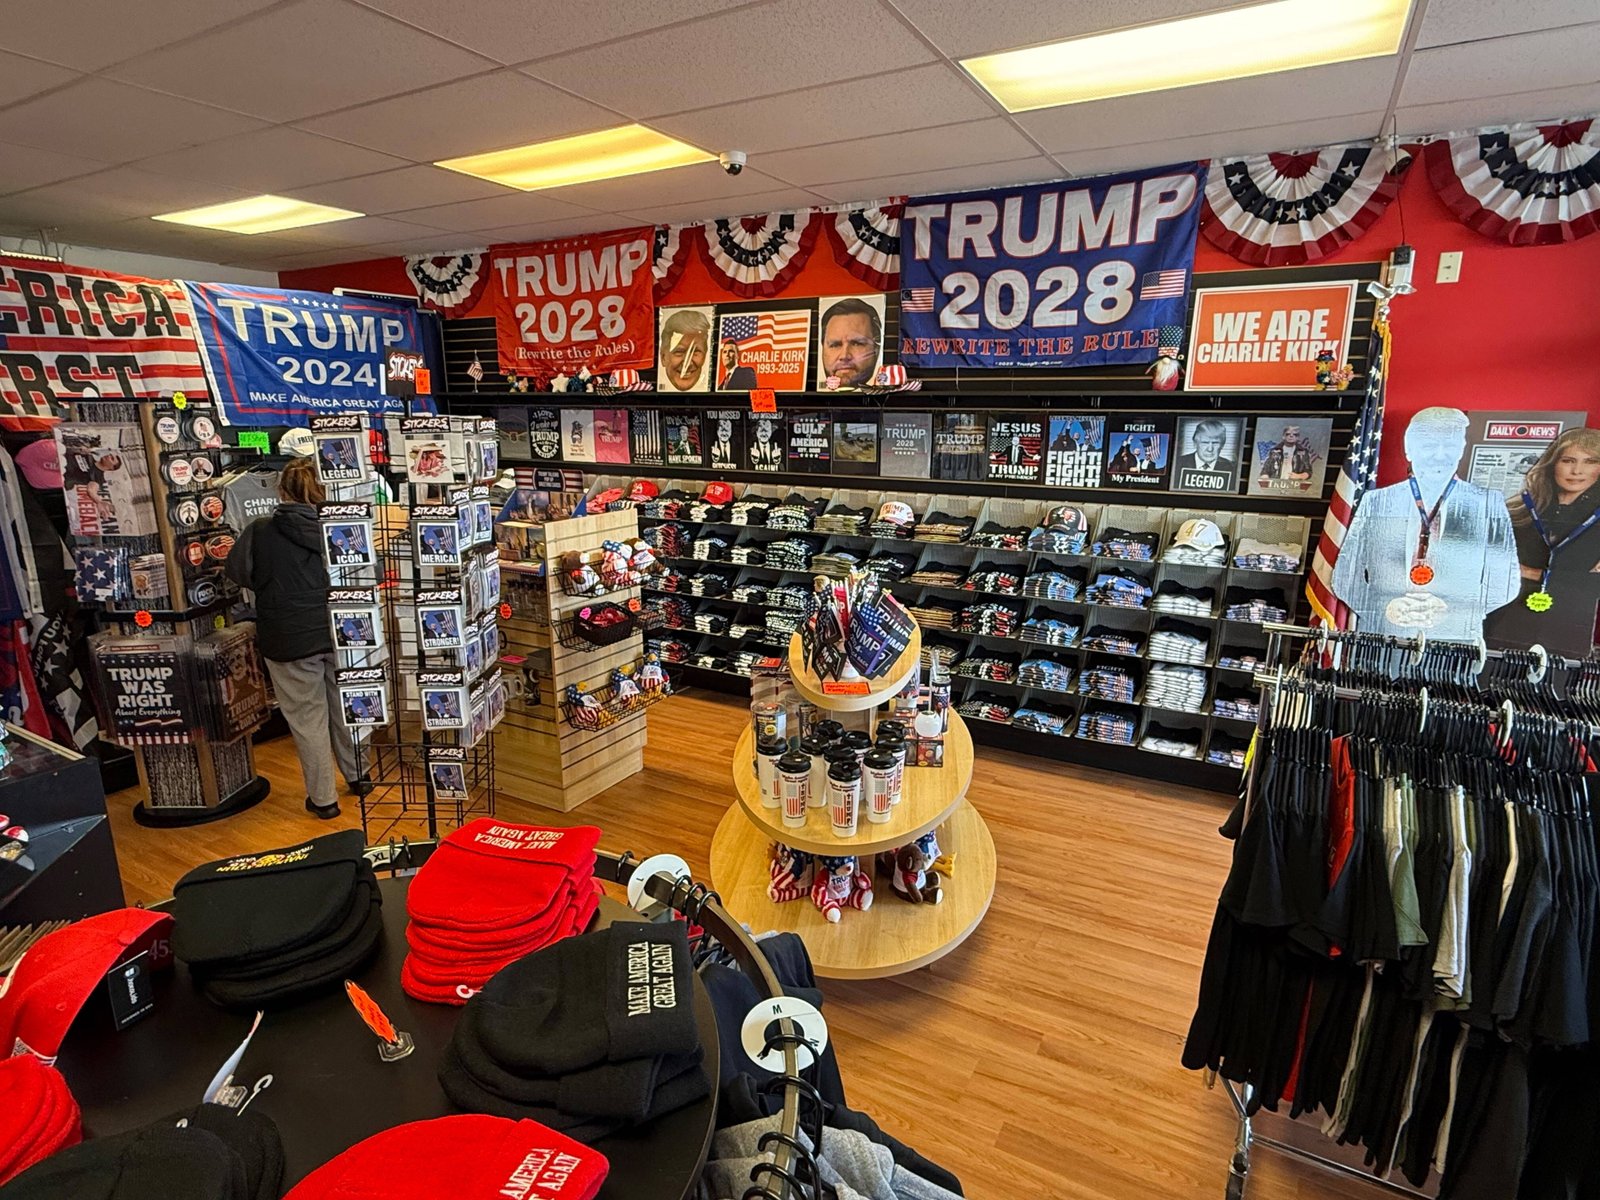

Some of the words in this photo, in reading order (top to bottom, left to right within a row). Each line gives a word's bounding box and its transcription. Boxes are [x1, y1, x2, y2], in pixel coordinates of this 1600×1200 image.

[903, 174, 1197, 260] TRUMP
[494, 239, 647, 297] TRUMP
[940, 261, 1136, 331] 2028
[515, 295, 626, 344] 2028
[1212, 311, 1262, 342] WE
[1265, 309, 1330, 341] ARE
[217, 298, 405, 354] TRUMP
[1019, 337, 1073, 356] THE
[1082, 329, 1159, 352] RULE
[514, 345, 563, 361] (Rewrite
[567, 344, 591, 359] the
[595, 339, 635, 357] Rules)
[1197, 342, 1281, 363] CHARLIE
[1284, 340, 1340, 362] KIRK
[741, 350, 780, 364] CHARLIE
[781, 349, 805, 362] KIRK
[276, 356, 377, 388] 2024
[756, 363, 800, 374] 1993-2025
[249, 391, 288, 404] MAKE
[291, 394, 342, 408] AMERICA
[344, 400, 380, 409] GREAT
[384, 400, 404, 409] AGA
[706, 411, 718, 420] YOU
[718, 411, 740, 420] MISSED
[312, 416, 358, 428] STICKERS
[402, 418, 449, 430] STICKERS
[991, 423, 1042, 433] JESUS
[793, 423, 825, 435] GULF
[884, 428, 926, 440] TRUMP
[1124, 424, 1156, 433] FIGHT!
[1489, 426, 1515, 437] DAILY
[1528, 426, 1556, 437] NEWS
[531, 431, 560, 443] TRUMP
[790, 438, 829, 448] AMERICA
[936, 433, 985, 445] TRUMP
[895, 440, 915, 448] 2028
[1047, 451, 1103, 465] FIGHT!
[322, 469, 360, 480] LEGEND
[989, 464, 1039, 475] TRUMP
[1046, 465, 1101, 478] FIGHT!
[1111, 474, 1124, 484] My
[1124, 475, 1160, 484] President
[1184, 474, 1225, 489] LEGEND
[244, 497, 280, 508] CHARL
[245, 506, 269, 517] KIRK
[319, 504, 368, 517] STICKERS
[412, 505, 457, 517] STICKERS
[1185, 523, 1208, 538] 47
[336, 553, 363, 565] ICON
[421, 554, 458, 564] MERICA!
[329, 590, 374, 602] STICKERS
[416, 590, 459, 602] STICKERS
[849, 618, 881, 652] RUMP
[424, 636, 461, 647] STRONGER!
[106, 667, 174, 682] TRUMP
[338, 668, 383, 681] STICKERS
[420, 673, 462, 684] STICKERS
[123, 681, 166, 695] WAS
[117, 694, 173, 708] RIGHT
[115, 708, 138, 717] About
[138, 708, 182, 718] Everything
[428, 719, 462, 727] STRONGER!
[428, 747, 465, 757] STICKERS
[486, 825, 528, 840] AGAIN
[525, 830, 565, 841] GREAT
[474, 832, 525, 850] AMERICA
[372, 851, 389, 863] XL
[831, 876, 848, 885] TRU
[627, 941, 650, 982] AMERICA
[652, 943, 675, 975] AGAIN
[653, 976, 677, 1009] GREAT
[627, 982, 652, 1017] MAKE
[772, 1004, 783, 1015] M
[536, 1152, 583, 1192] AGAIN
